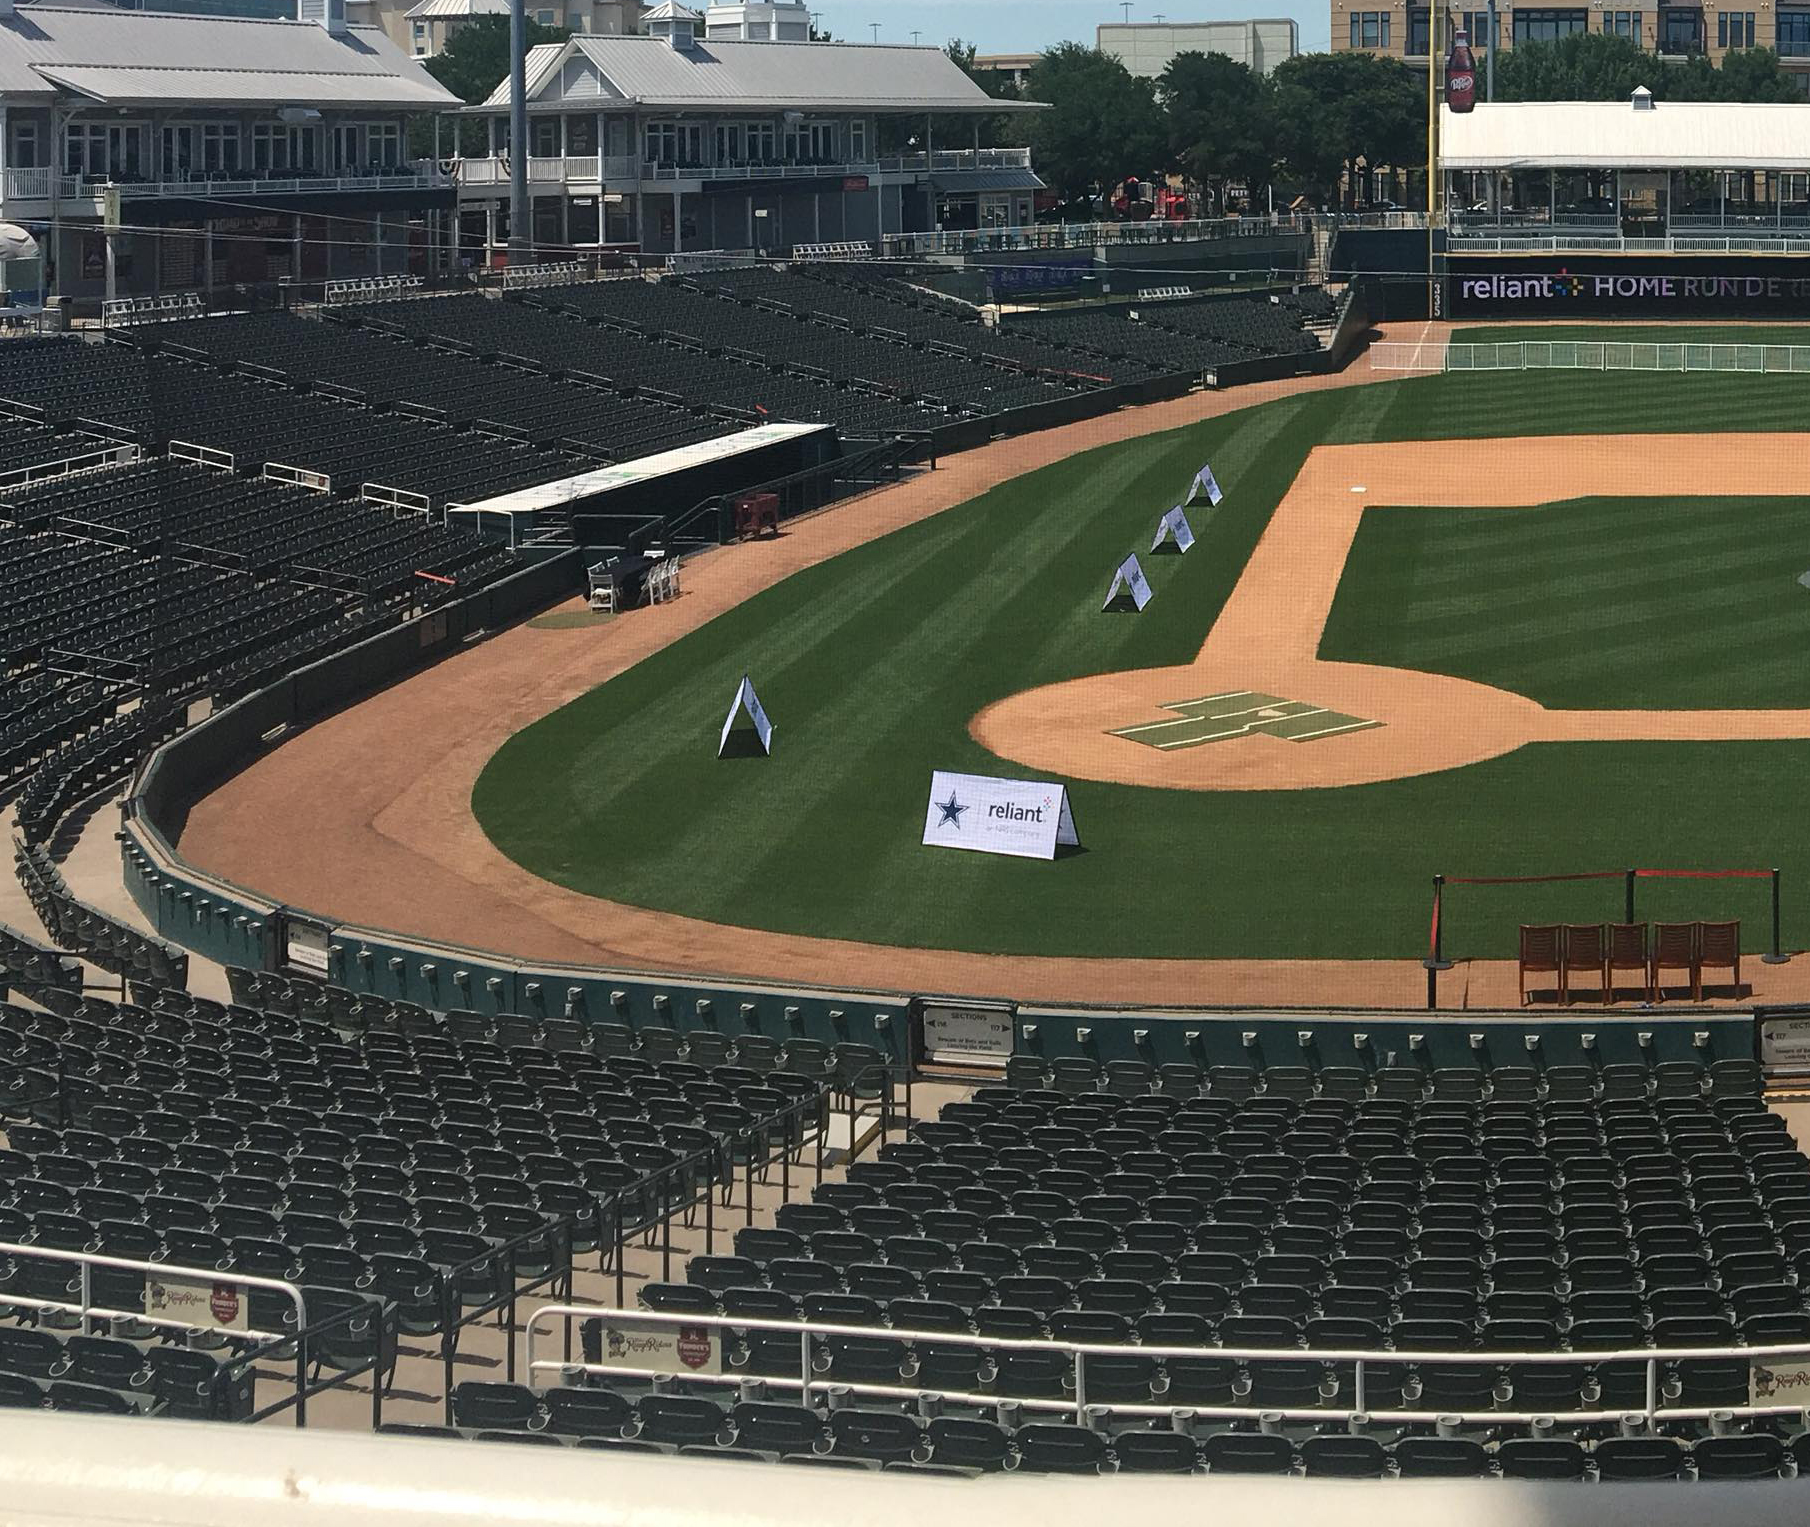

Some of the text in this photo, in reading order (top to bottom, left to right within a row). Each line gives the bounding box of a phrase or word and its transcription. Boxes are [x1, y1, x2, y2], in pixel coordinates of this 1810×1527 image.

[1462, 275, 1553, 298] reliant
[1594, 277, 1676, 297] HOME
[1684, 278, 1738, 296] RUN
[988, 802, 1043, 823] reliant
[951, 1013, 987, 1021] SECTIONS
